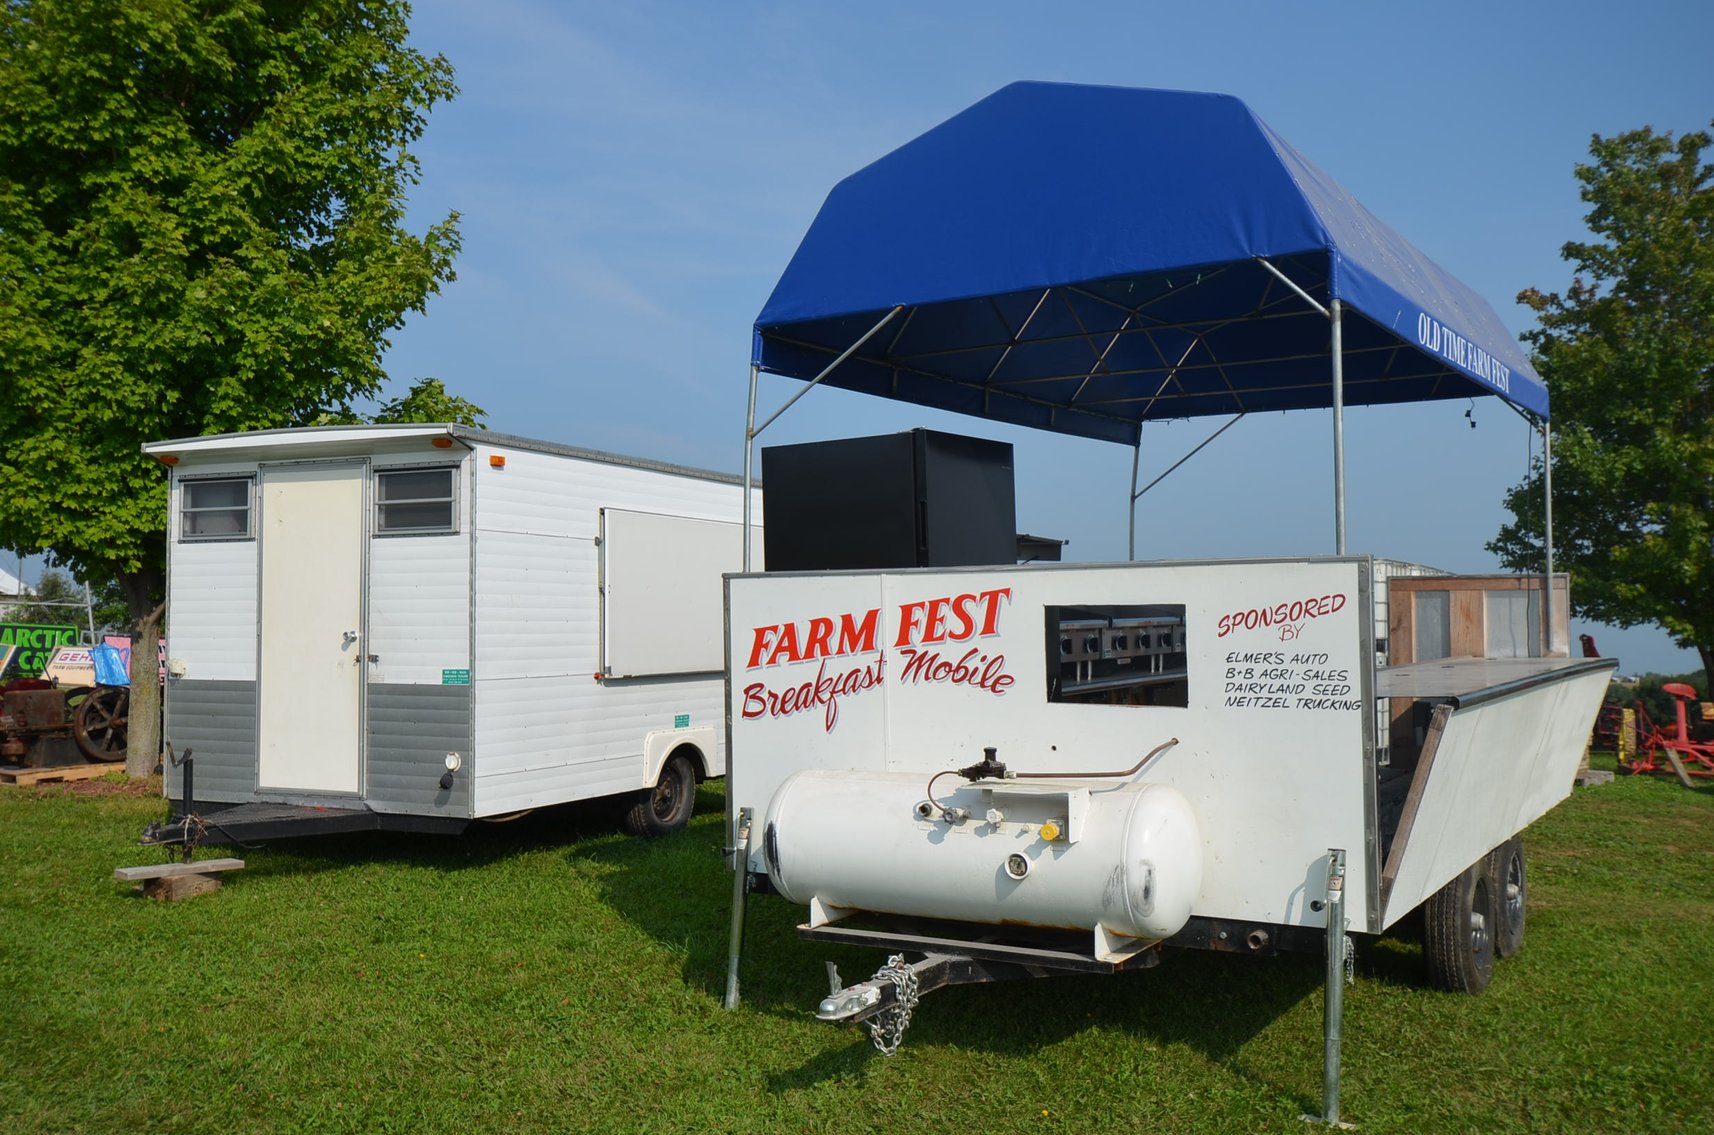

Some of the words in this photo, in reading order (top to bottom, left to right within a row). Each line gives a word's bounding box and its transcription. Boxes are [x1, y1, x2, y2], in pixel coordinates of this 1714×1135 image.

[1418, 312, 1440, 352] OLD
[1442, 326, 1466, 368] TIME
[1467, 342, 1492, 382] FARM
[1491, 357, 1510, 395] FEST
[1217, 593, 1347, 638] SPONSORED
[746, 607, 882, 669] FARM
[893, 587, 1012, 648] FEST
[1277, 622, 1306, 642] BY
[0, 628, 74, 649] ARCTIC
[18, 650, 52, 670] CA
[59, 653, 93, 661] GEH
[1225, 651, 1285, 665] ELMER'S
[1289, 653, 1329, 665] AUTO
[742, 649, 886, 732] Breakfast
[900, 648, 1015, 694] Mobile
[1224, 682, 1306, 695] DAIRYLAND
[1312, 684, 1351, 696] SEED
[1224, 696, 1290, 709] NEITZEL
[1295, 698, 1363, 711] TRUCKING
